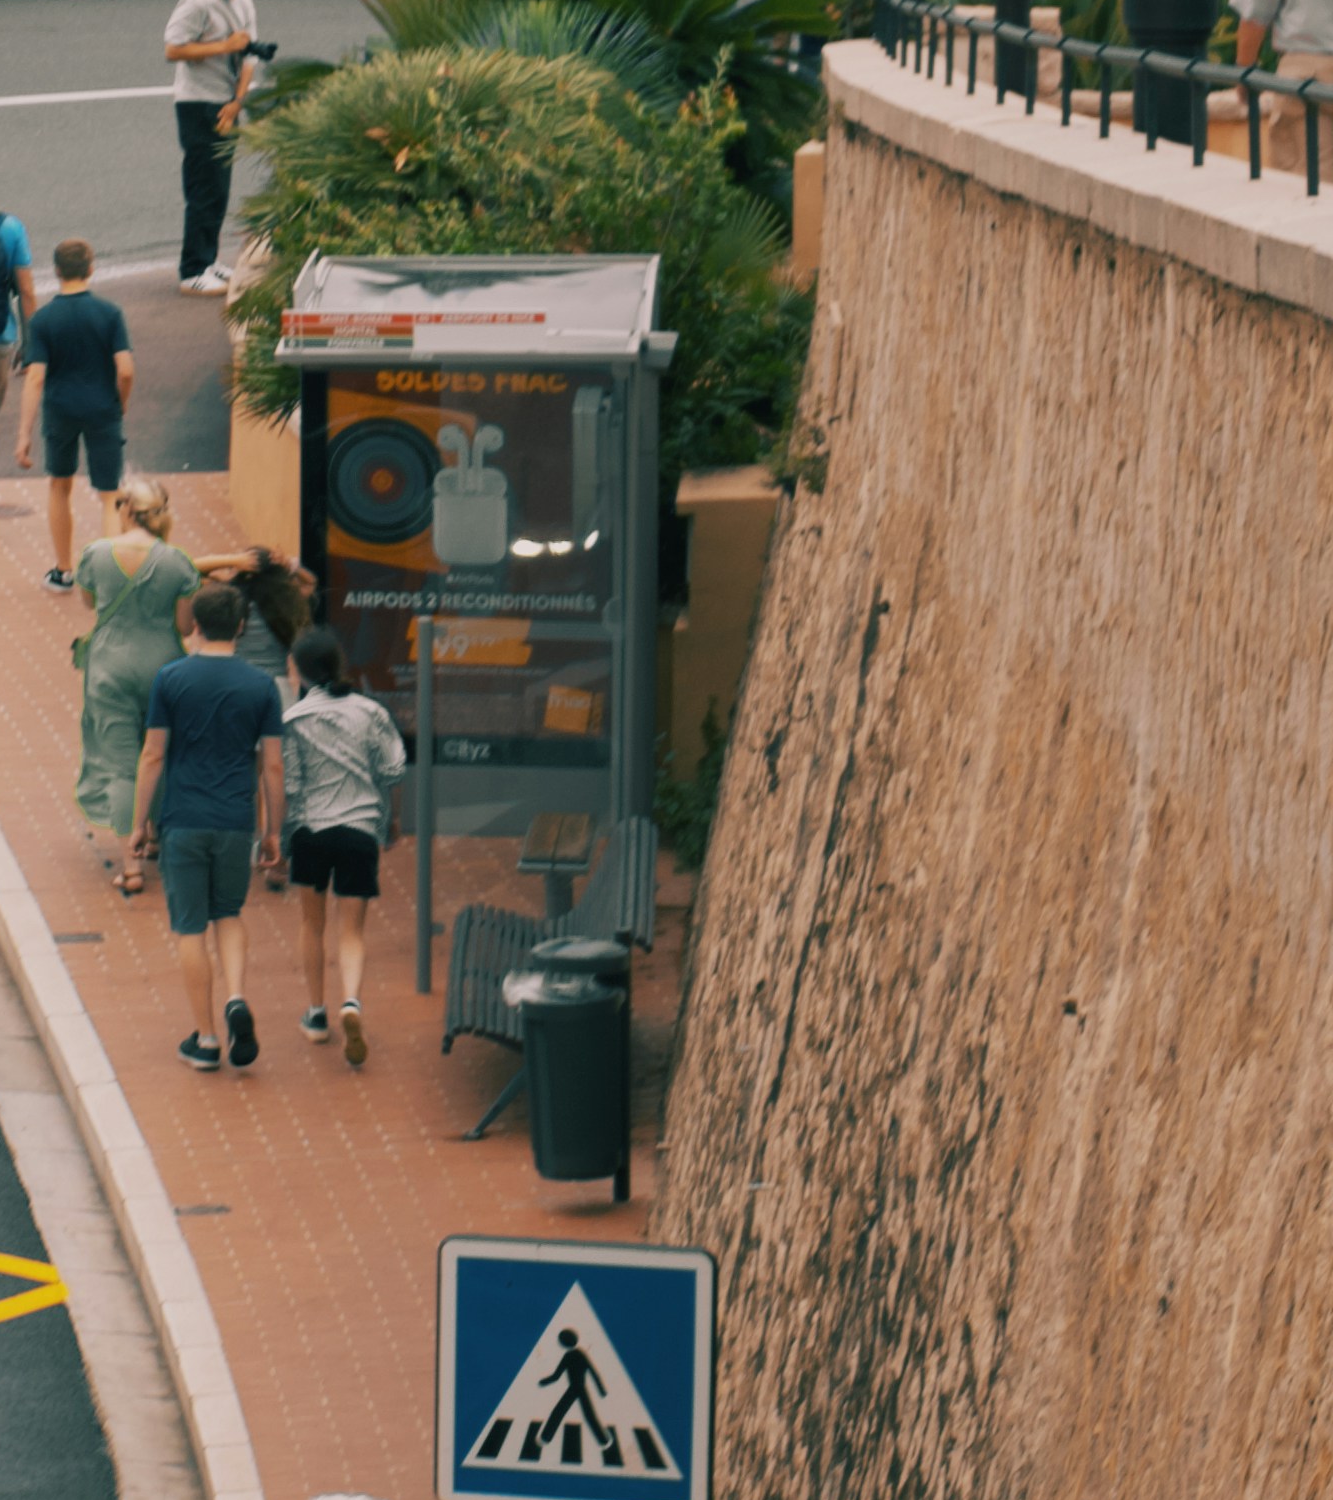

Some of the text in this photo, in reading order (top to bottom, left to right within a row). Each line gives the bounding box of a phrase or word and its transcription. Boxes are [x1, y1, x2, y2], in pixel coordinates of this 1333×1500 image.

[376, 369, 568, 394] SOLDES FNAC
[342, 590, 597, 612] AIRPODS 2 RECONDITIONNÉS
